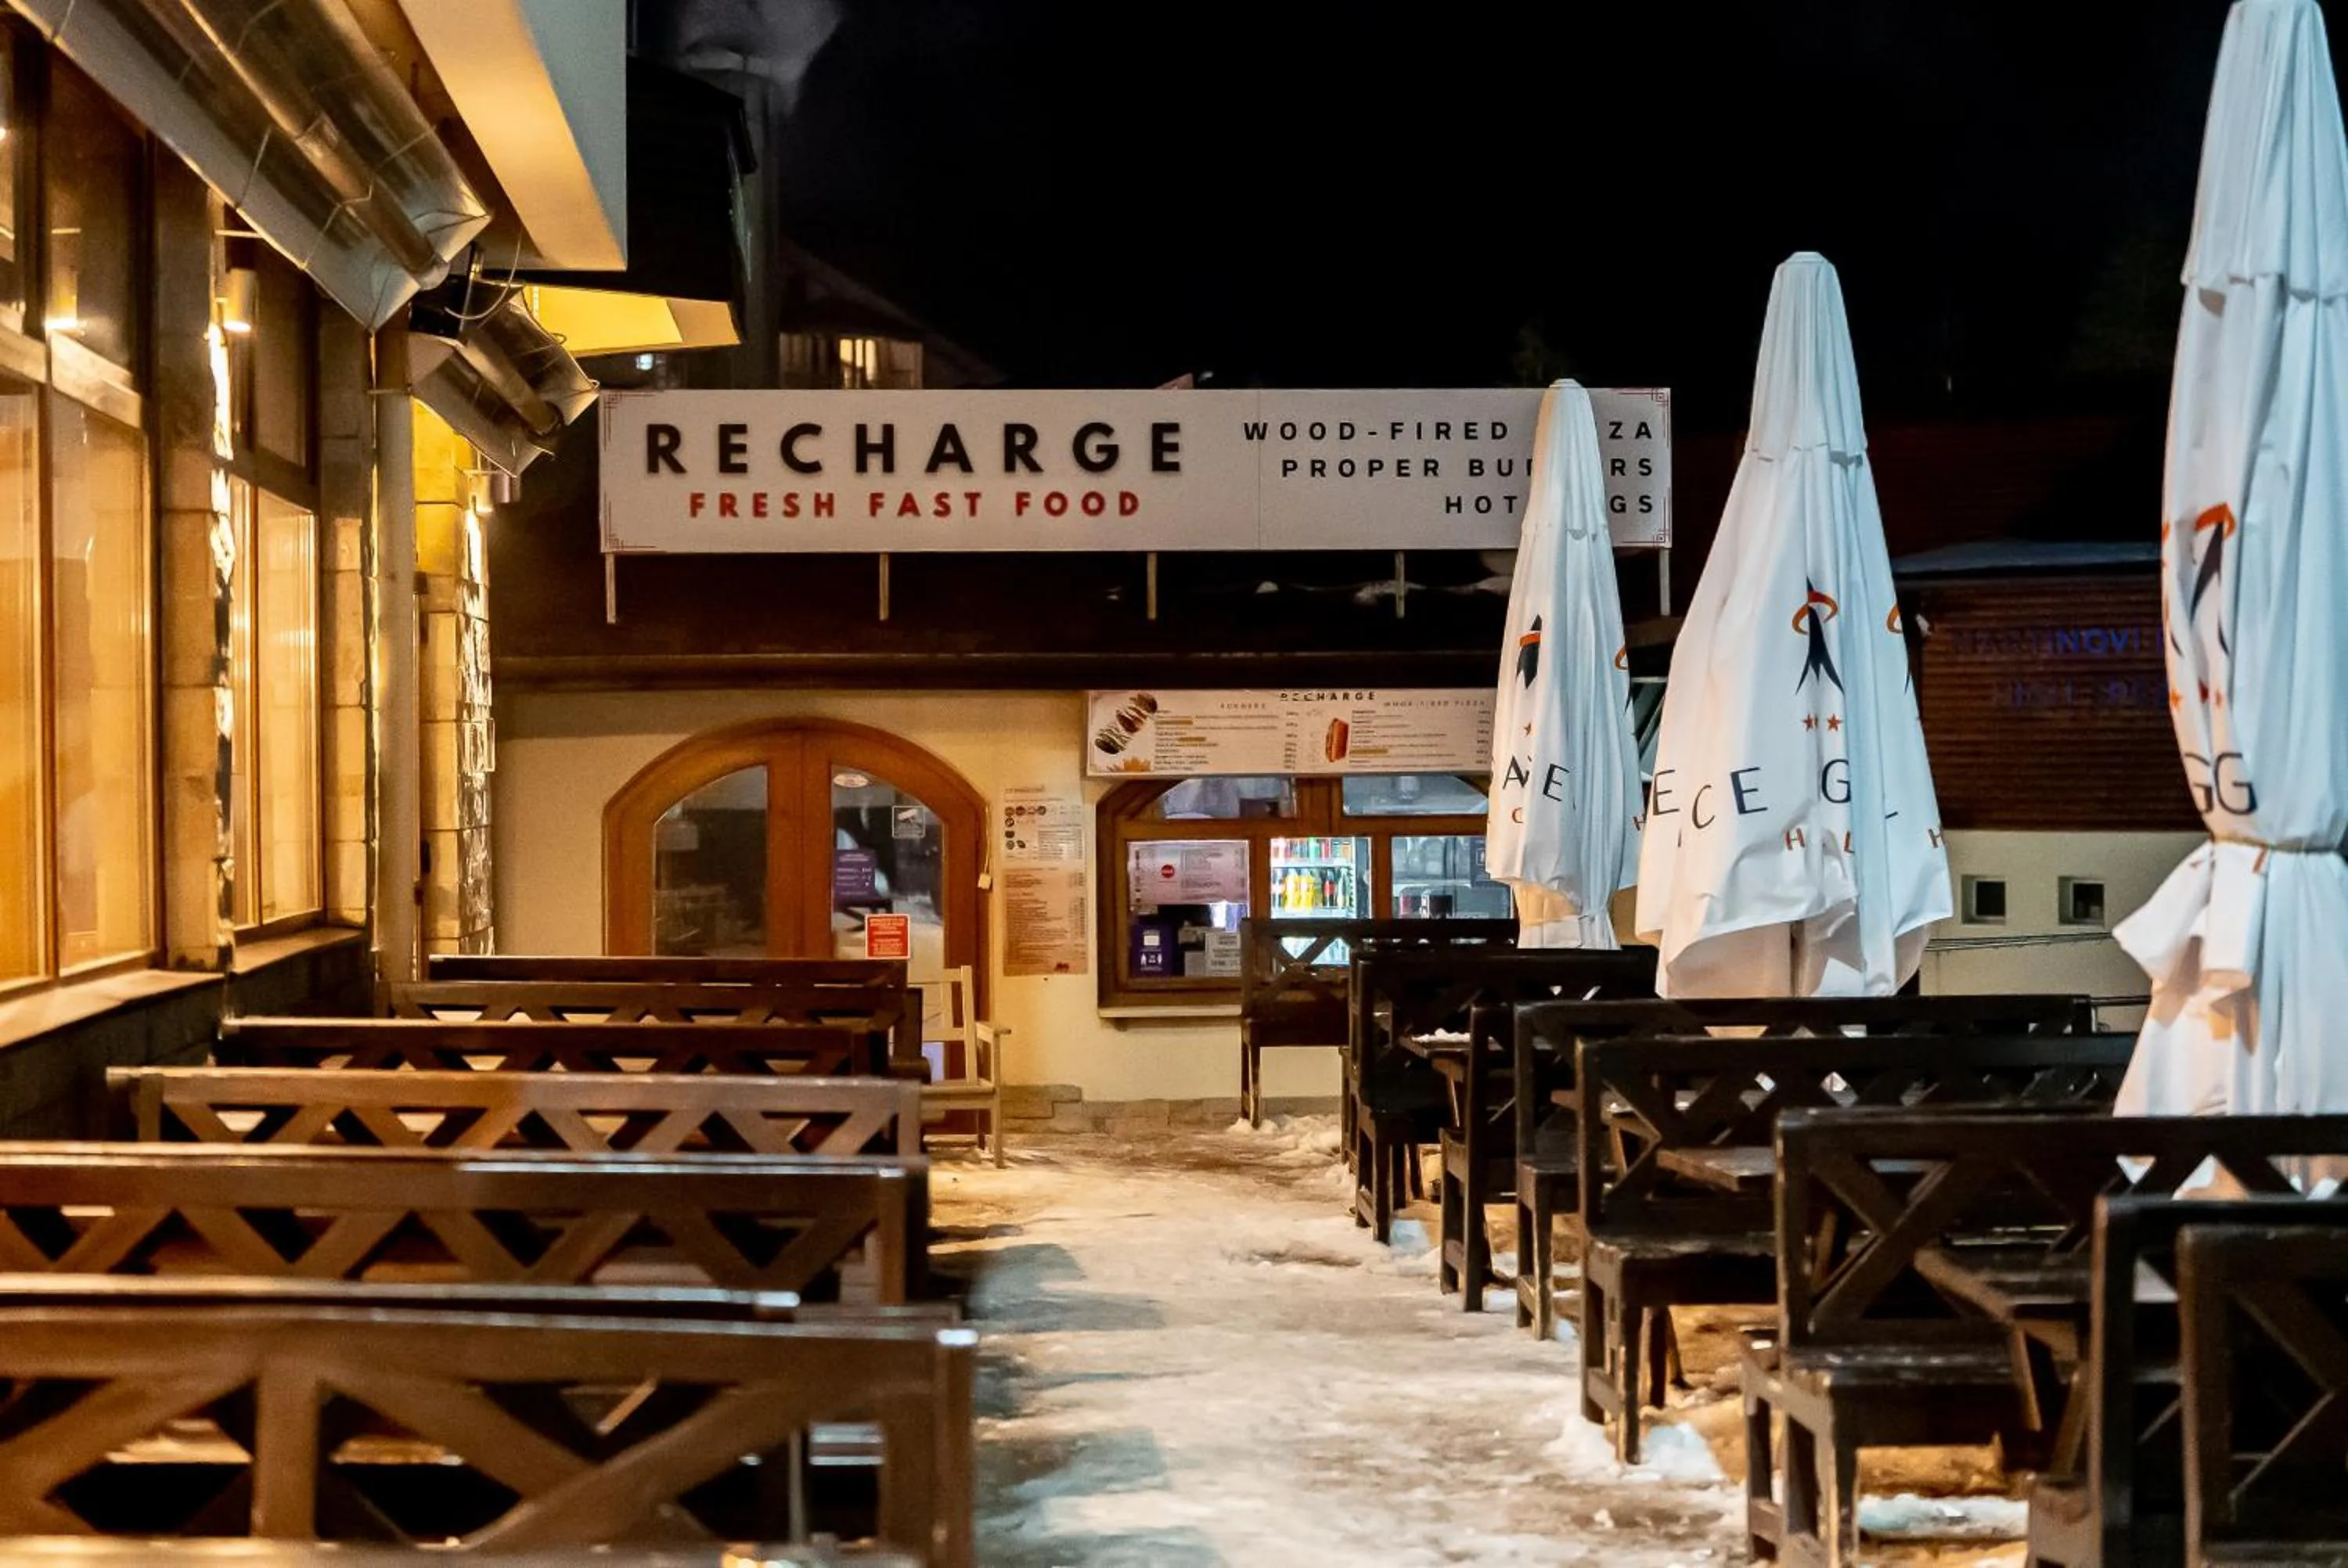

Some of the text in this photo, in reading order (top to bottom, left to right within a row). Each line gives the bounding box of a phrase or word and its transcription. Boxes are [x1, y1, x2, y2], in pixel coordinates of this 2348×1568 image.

[1243, 421, 1509, 441] WOOD-FIRED
[646, 422, 1182, 476] RECHARGE
[1281, 456, 1653, 478] PROPER BURS
[690, 491, 1140, 518] FRESH FAST FOOD
[1445, 494, 1518, 514] HOT
